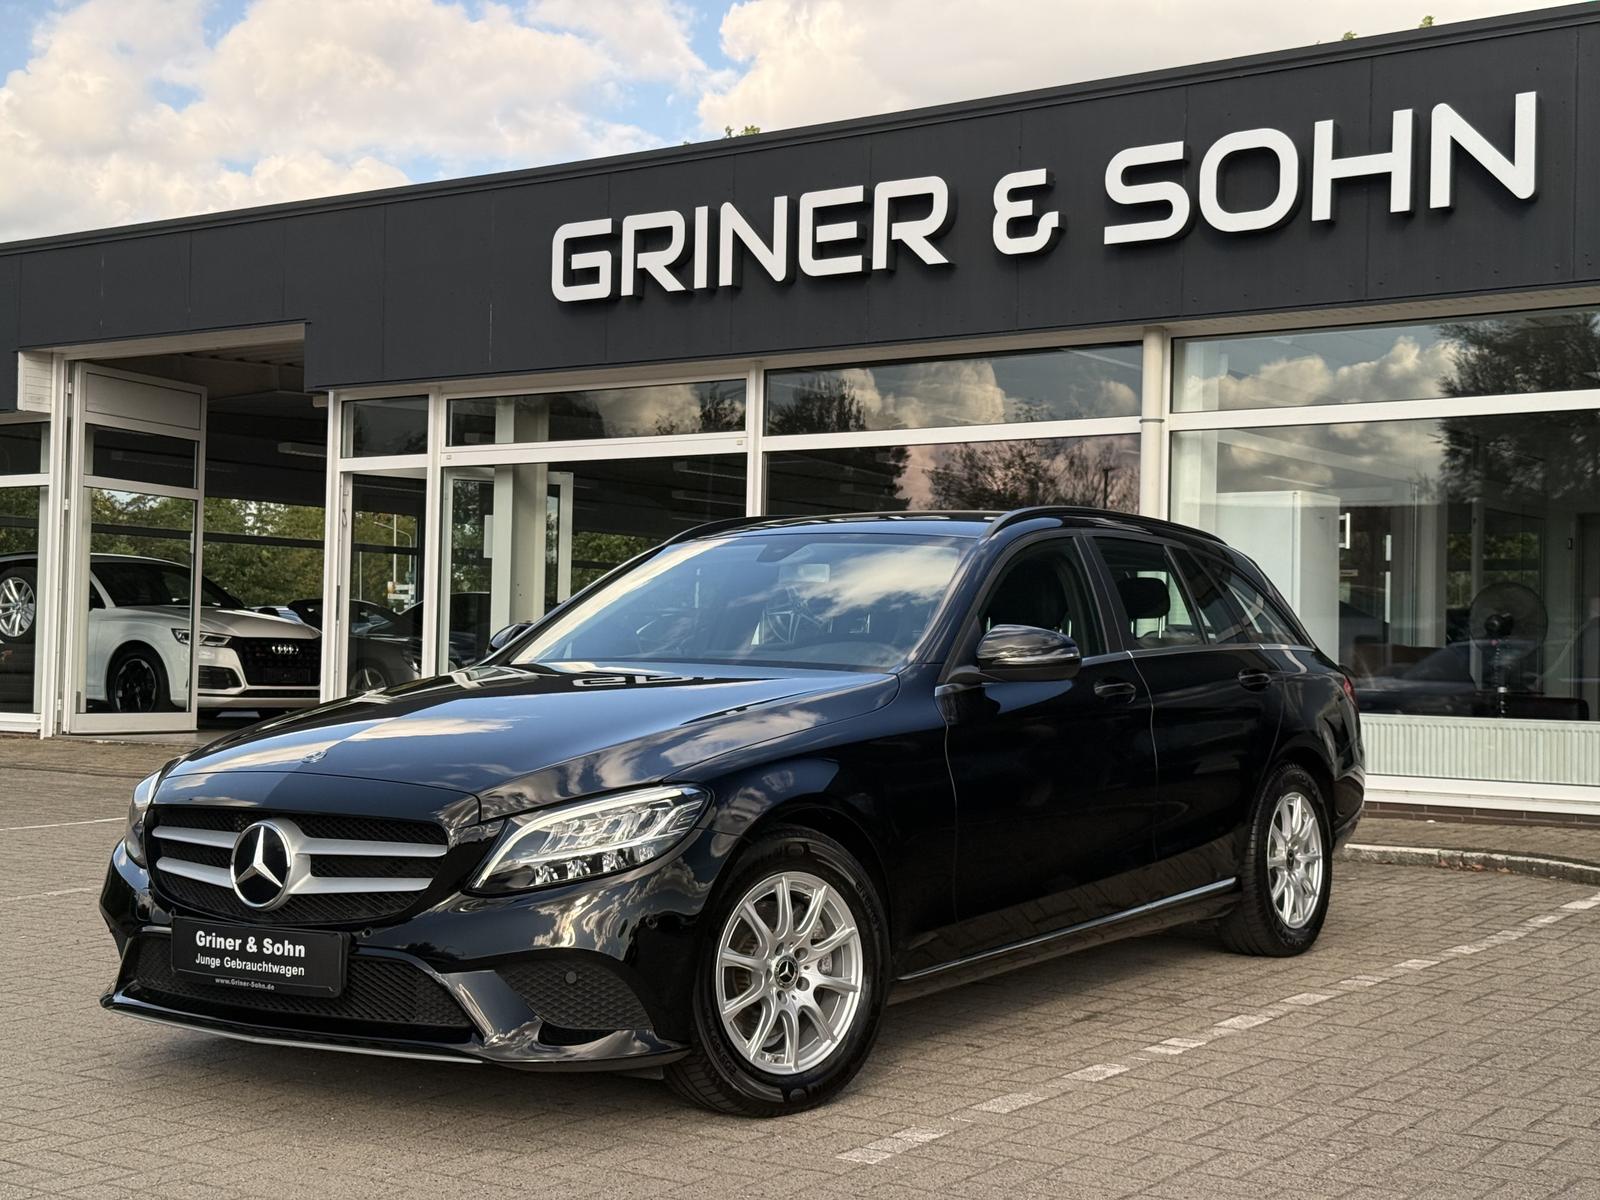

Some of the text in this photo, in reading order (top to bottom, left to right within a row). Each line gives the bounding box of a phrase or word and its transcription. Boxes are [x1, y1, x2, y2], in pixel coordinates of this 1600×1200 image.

[551, 91, 1537, 303] GRINER & SOHN
[195, 930, 306, 957] Griner & Sohn
[195, 953, 305, 977] Junge Gebrauchtwagen
[215, 977, 275, 991] www.Griner-Sohn.de
